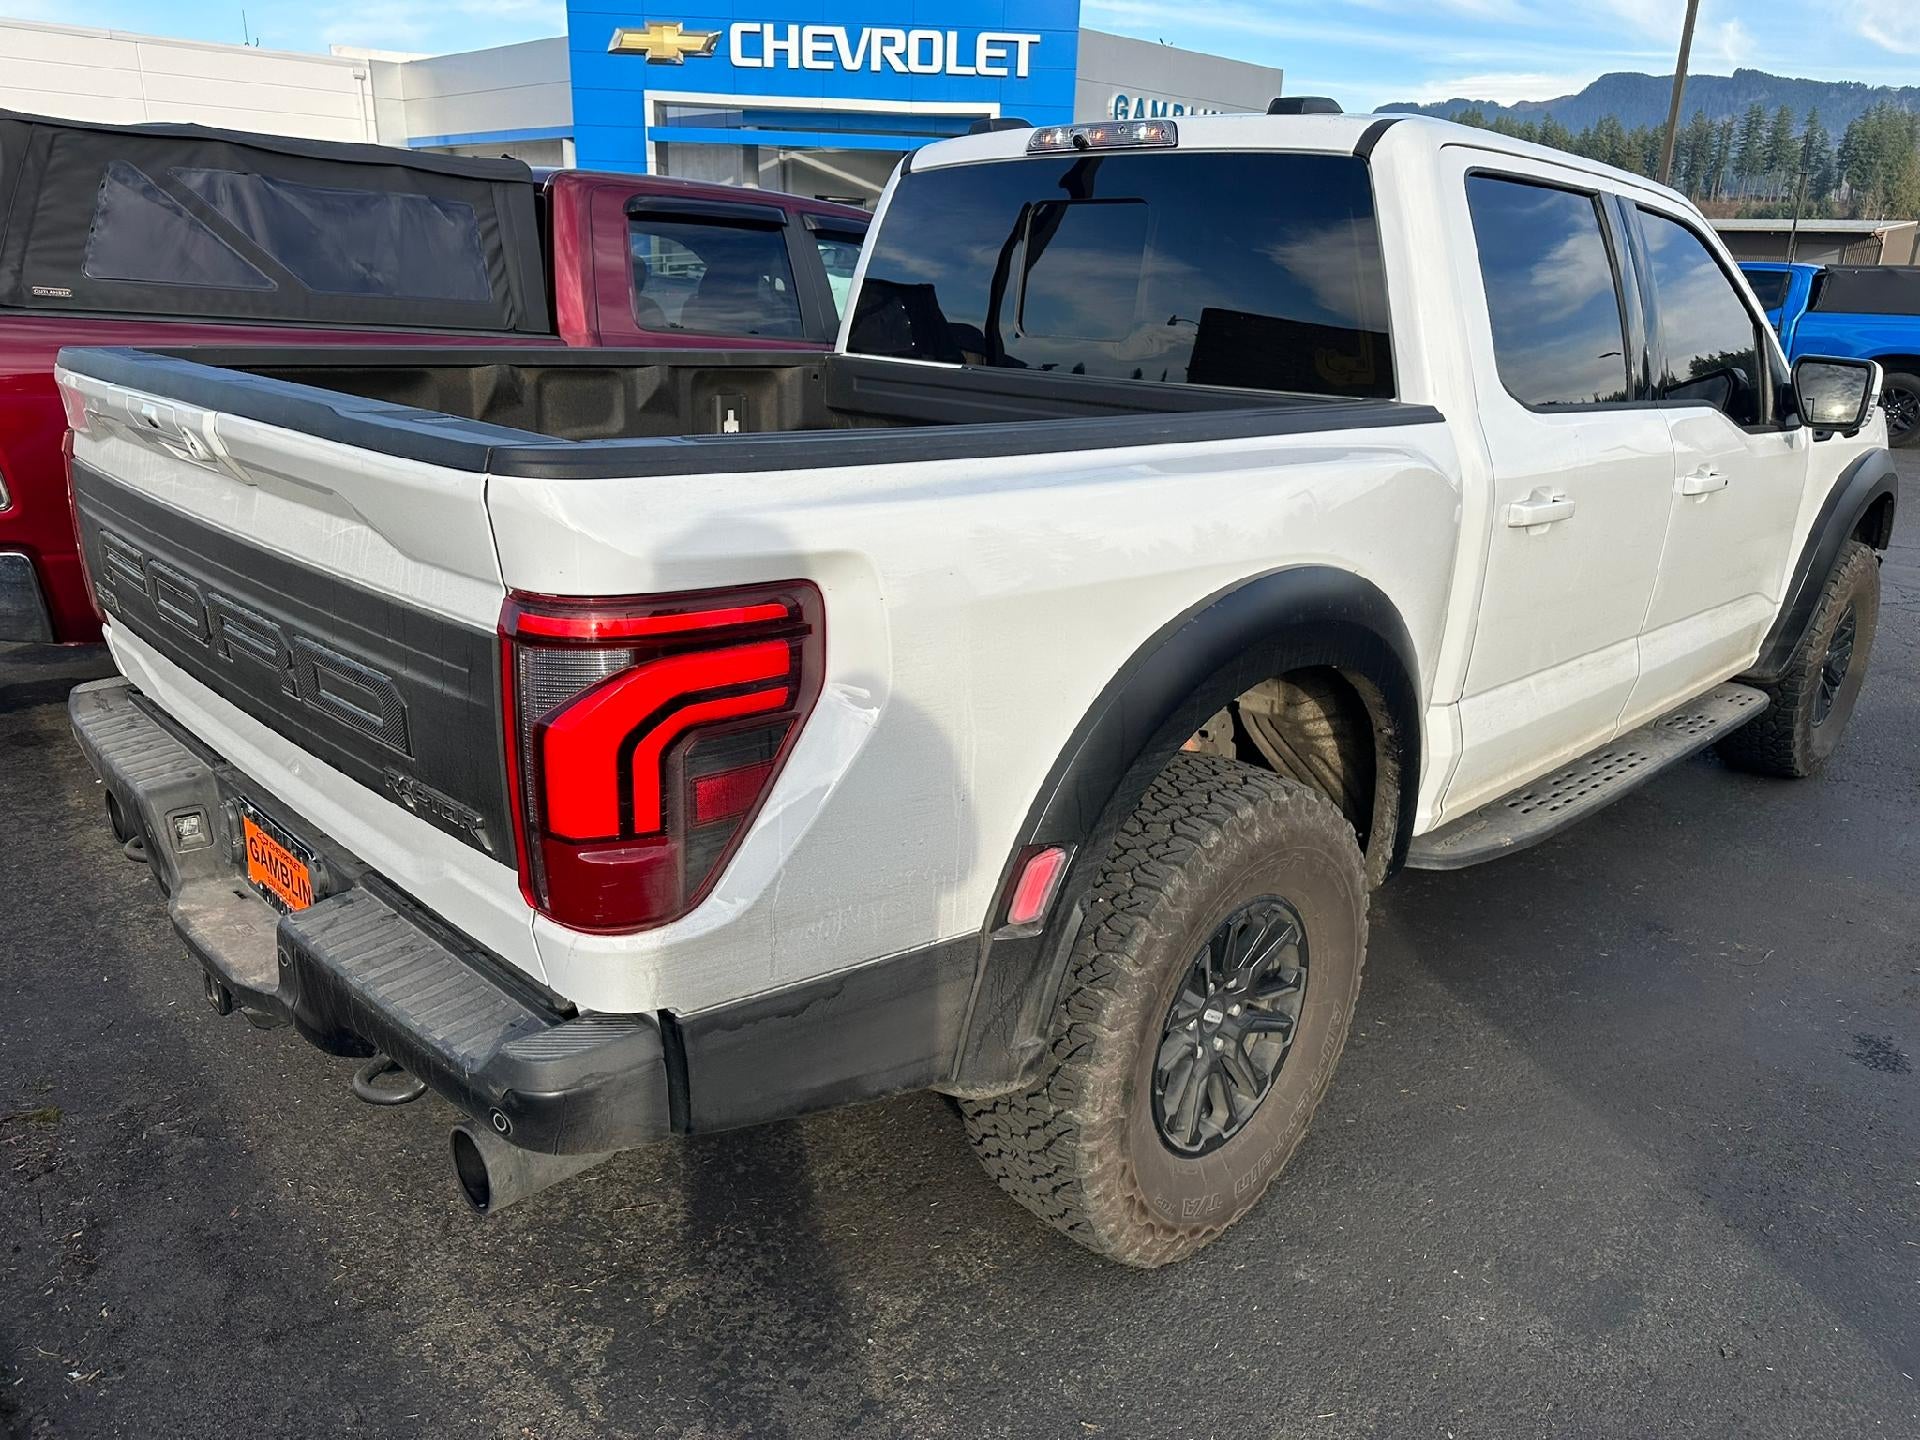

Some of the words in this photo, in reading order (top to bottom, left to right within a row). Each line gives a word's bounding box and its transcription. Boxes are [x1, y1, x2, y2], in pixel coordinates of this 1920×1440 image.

[729, 22, 1041, 77] CHEVROLET
[99, 529, 415, 761] FORD
[384, 767, 494, 854] RAPTOR
[249, 836, 311, 906] GAMBLIN
